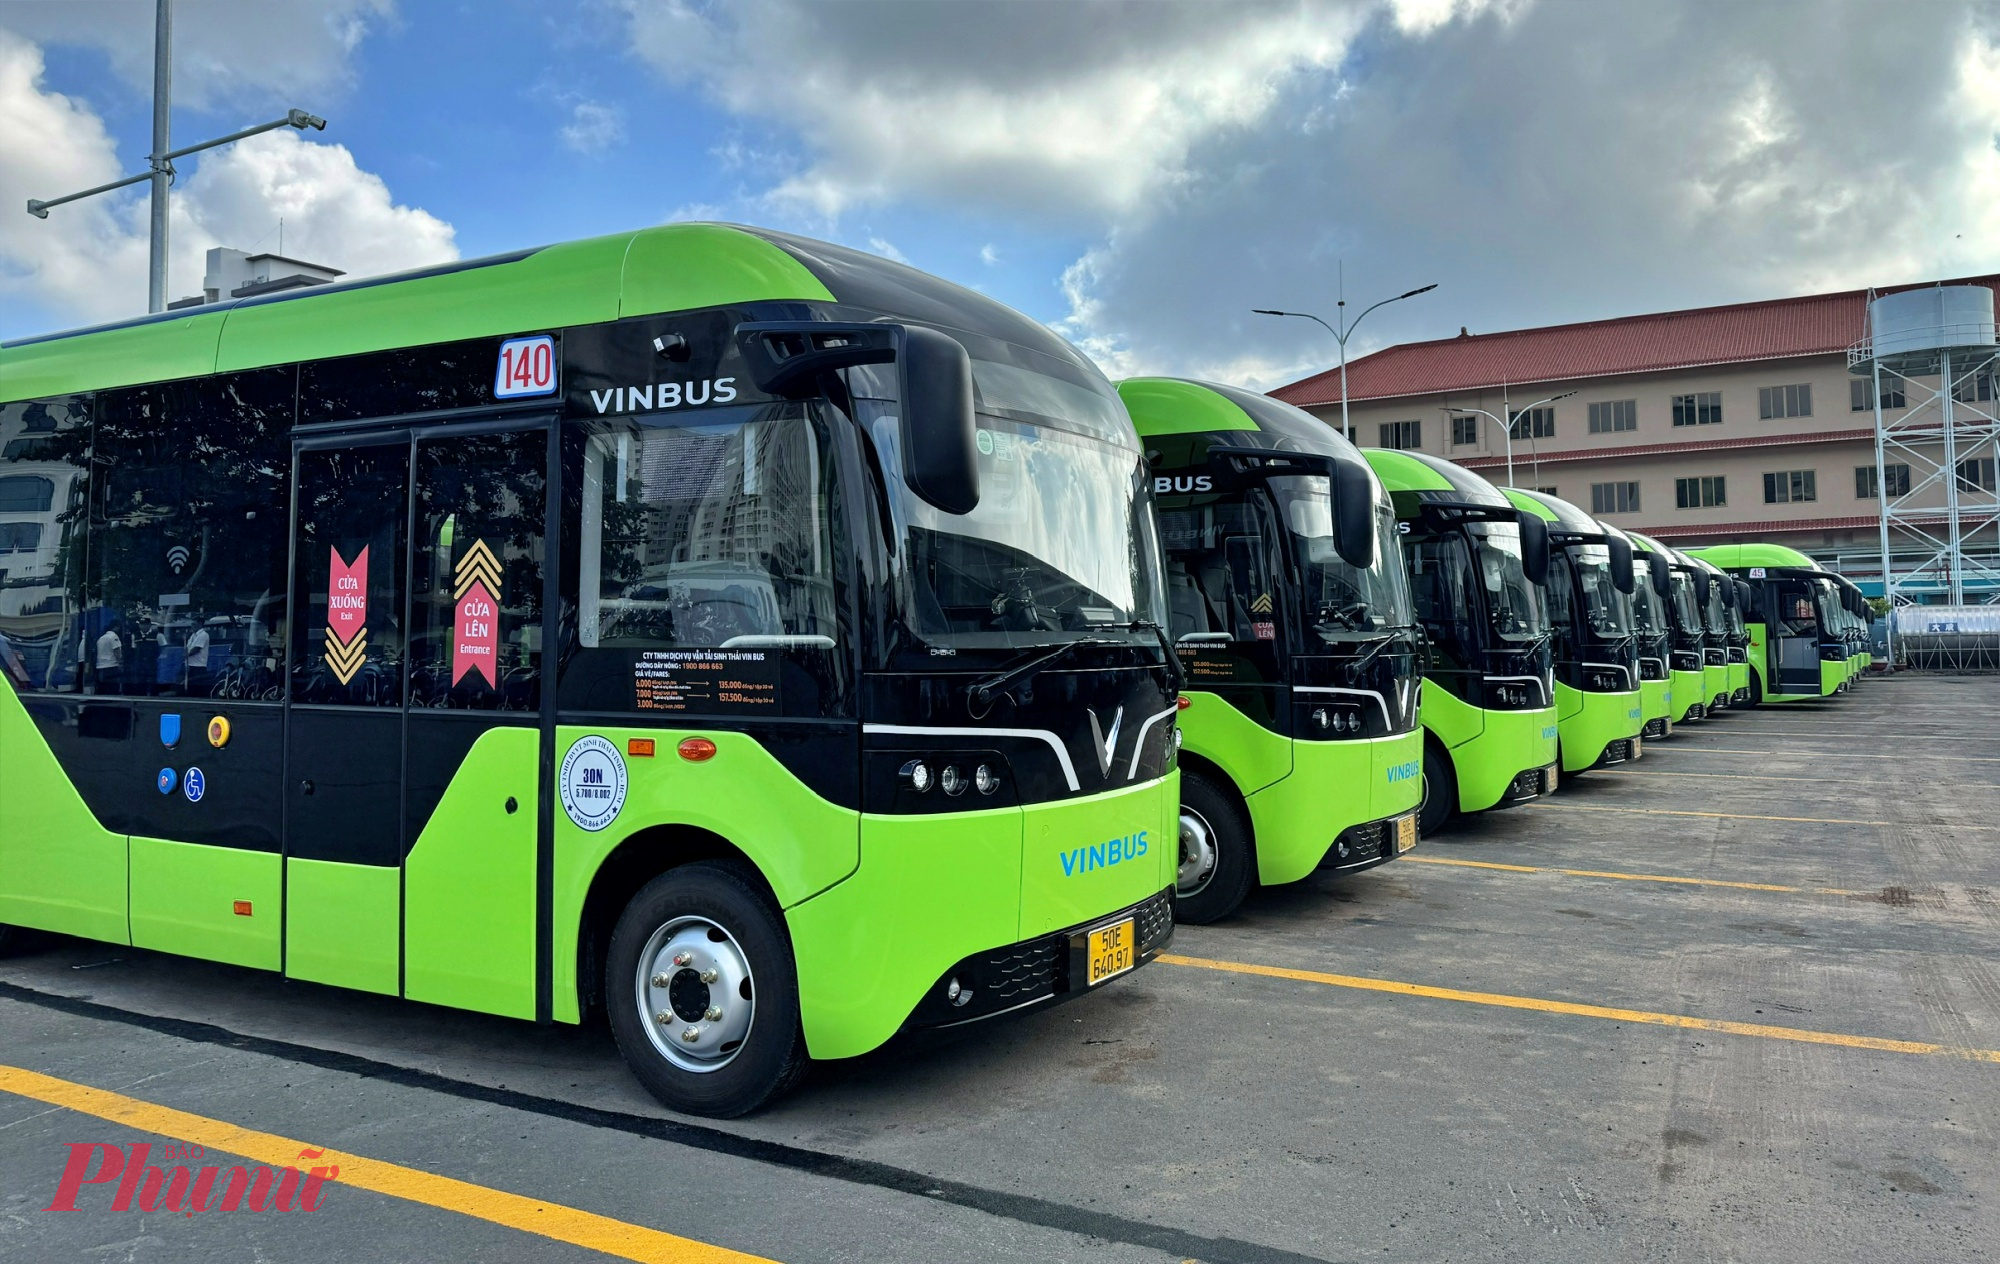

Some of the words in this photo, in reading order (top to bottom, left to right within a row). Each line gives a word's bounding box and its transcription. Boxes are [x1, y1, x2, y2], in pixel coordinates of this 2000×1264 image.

[502, 343, 551, 390] 140
[590, 377, 737, 414] VINBUS
[1154, 475, 1213, 493] BUS
[1751, 568, 1763, 578] 45
[338, 574, 358, 590] CỬA
[330, 592, 365, 609] XUỐNG
[464, 598, 490, 617] CỬA
[340, 612, 353, 621] Exit
[465, 619, 488, 638] LÊN
[460, 643, 491, 655] Entrance
[642, 652, 653, 660] CTY
[713, 652, 727, 660] SINH
[753, 653, 765, 661] BUS
[718, 680, 742, 689] 135.000
[718, 692, 742, 702] 157.500
[583, 768, 603, 783] 30N
[1386, 760, 1419, 783] VINBUS
[1060, 831, 1148, 877] VINBUS
[1101, 926, 1122, 953] 50E
[1093, 947, 1129, 979] 640.97
